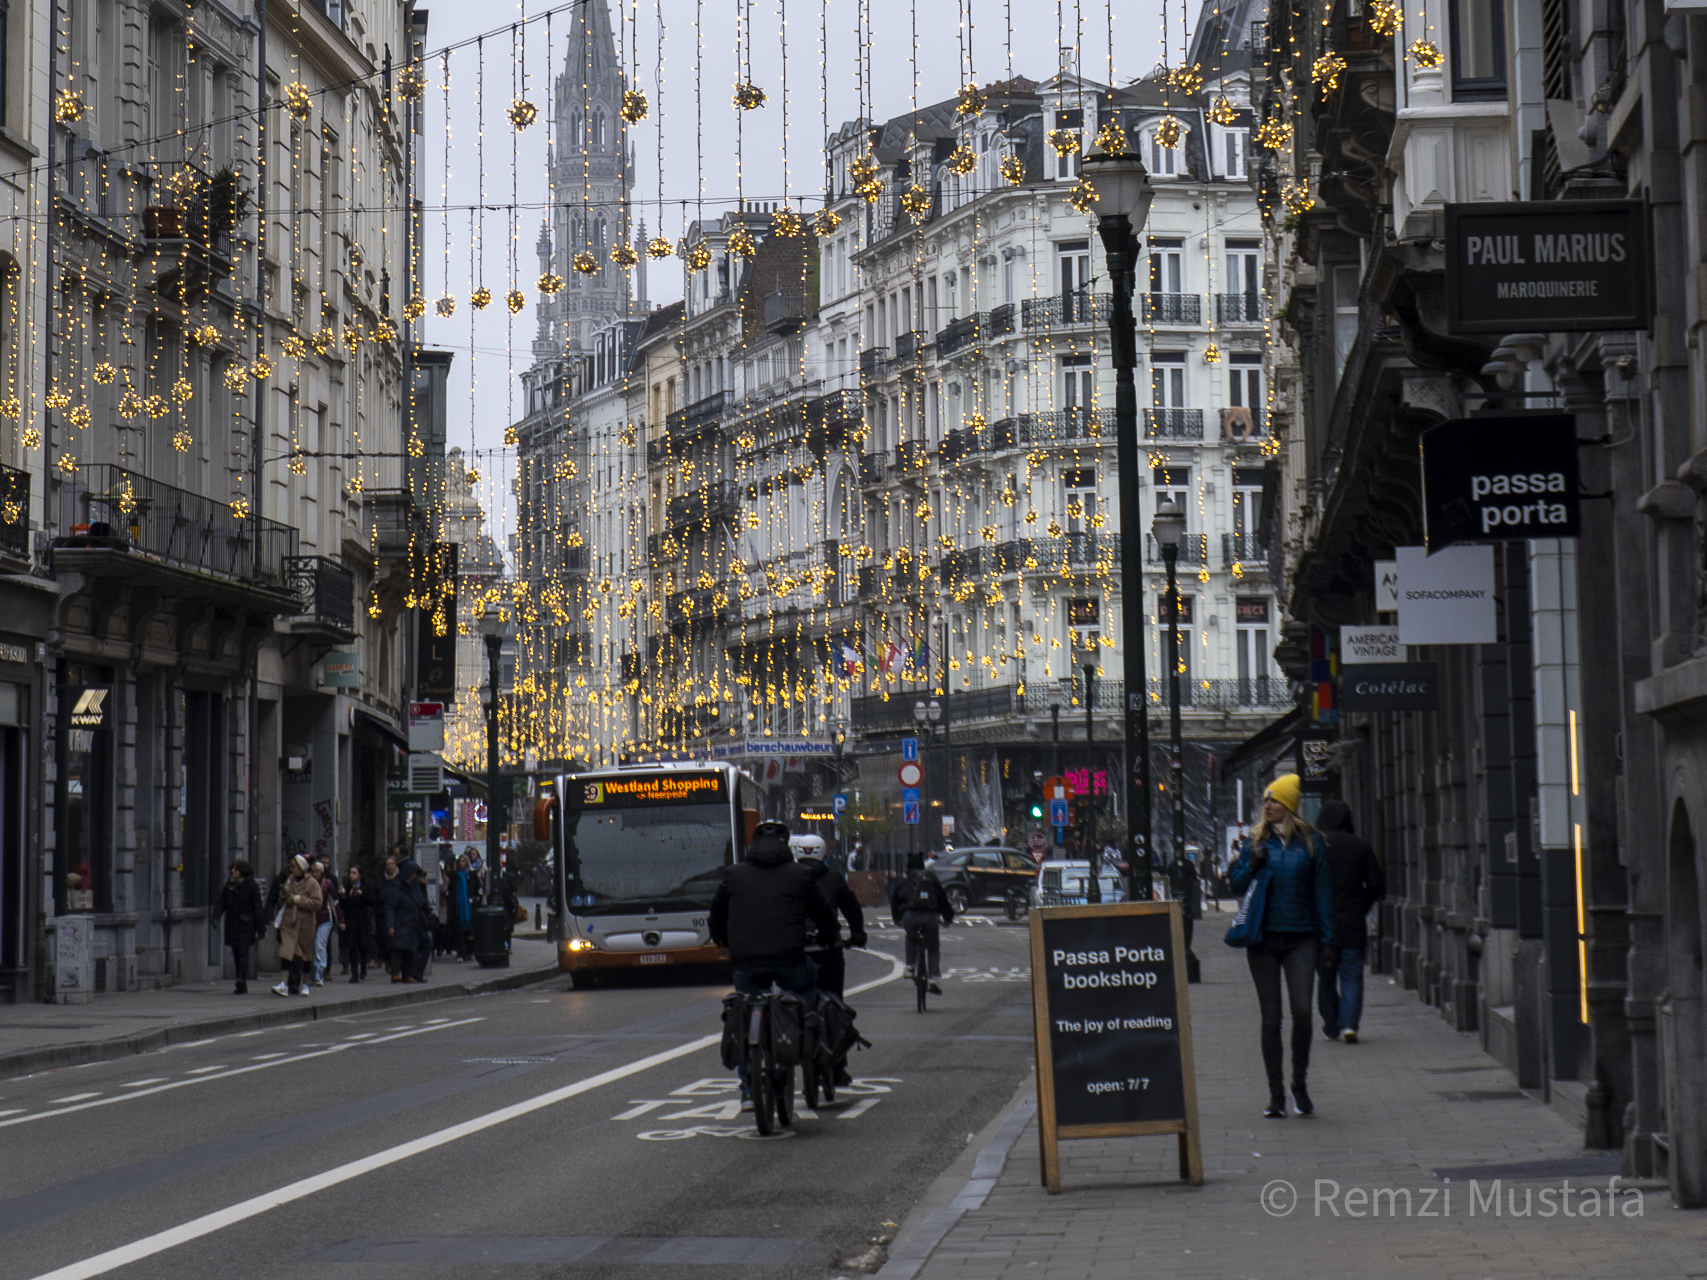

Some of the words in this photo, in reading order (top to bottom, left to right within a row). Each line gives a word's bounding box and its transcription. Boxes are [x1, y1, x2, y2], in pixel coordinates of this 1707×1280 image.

[1467, 235, 1526, 265] PAUL
[1534, 232, 1626, 263] MARIUS
[1497, 280, 1598, 299] MAROQUINERIE
[1470, 472, 1567, 502] passa
[1481, 499, 1568, 534] porta
[1406, 590, 1486, 600] SOFACOMPANY
[1352, 645, 1398, 656] VINTAGE
[605, 778, 659, 794] Westland
[661, 777, 719, 792] Shopping
[1053, 949, 1110, 966] Passa
[1115, 945, 1165, 963] Porta
[1063, 970, 1157, 989] bookshop
[1056, 1020, 1081, 1032] The
[1084, 1019, 1104, 1034] joy
[1107, 1017, 1120, 1030] of
[1123, 1015, 1172, 1030] reading
[1087, 1080, 1124, 1095] open:
